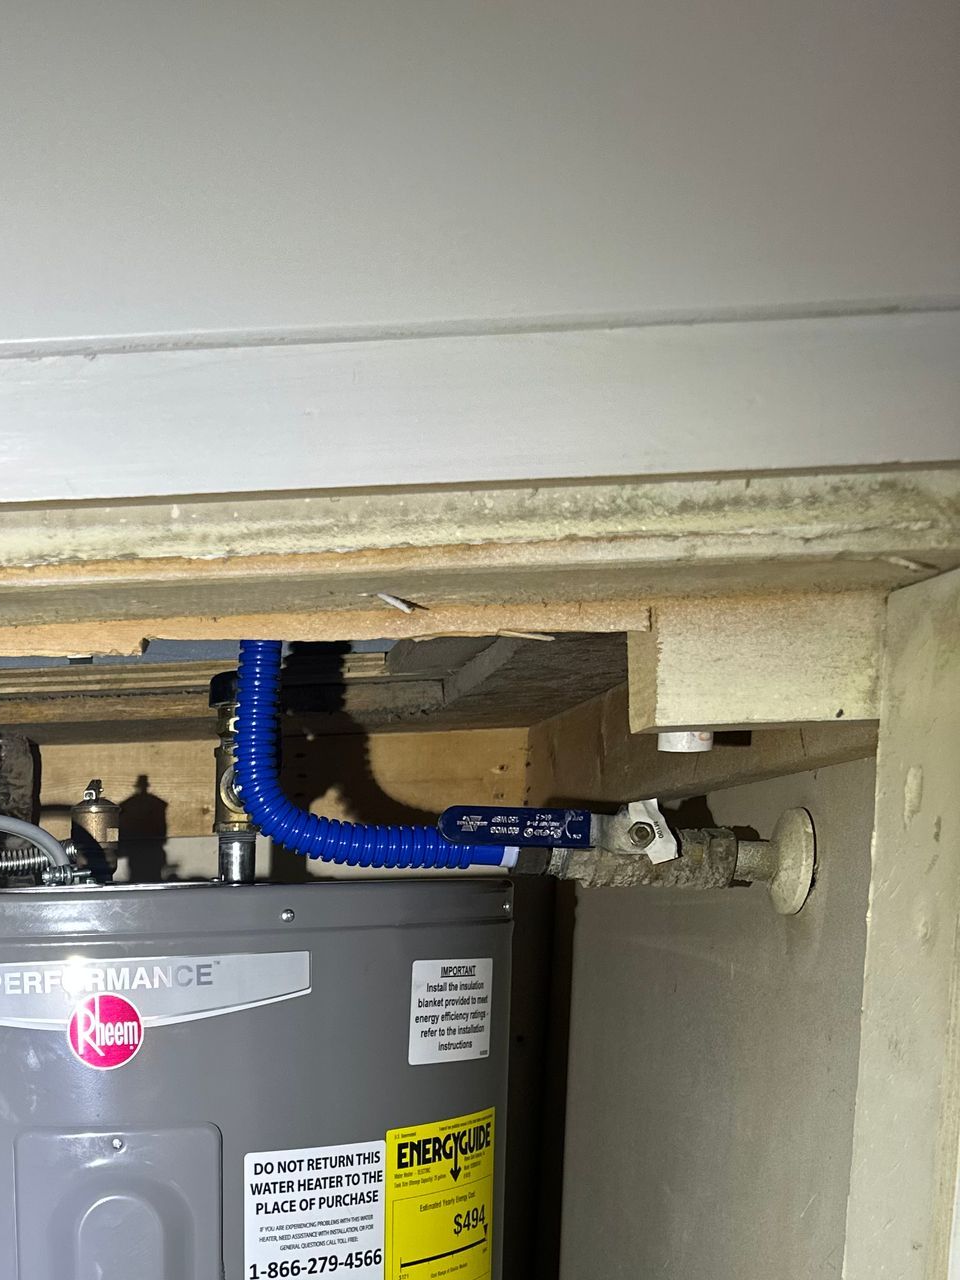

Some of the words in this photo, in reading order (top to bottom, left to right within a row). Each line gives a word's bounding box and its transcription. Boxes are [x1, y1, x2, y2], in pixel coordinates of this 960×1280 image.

[440, 965, 476, 977] IMPORTANT
[427, 982, 447, 992] Install
[449, 982, 458, 991] the
[459, 981, 484, 990] insulation
[418, 998, 443, 1008] blanket
[445, 996, 470, 1008] provided
[415, 1014, 439, 1024] energy
[441, 1010, 469, 1022] efficiency
[75, 994, 139, 1056] Rheem
[421, 1027, 437, 1038] refer
[447, 1026, 456, 1035] the
[458, 1024, 484, 1034] installation
[397, 1122, 491, 1171] ENERGYGUIDE
[254, 1162, 274, 1175] DO
[278, 1159, 304, 1174] NOT
[307, 1154, 354, 1171] RETURN
[356, 1151, 381, 1165] THIS
[250, 1180, 294, 1195] WATER
[298, 1175, 343, 1192] HEATER
[345, 1173, 360, 1187] TO
[362, 1170, 383, 1184] THE
[256, 1200, 296, 1215] PLACE
[300, 1197, 315, 1211] OF
[319, 1190, 379, 1209] PURCHASE
[420, 1200, 441, 1212] Estimated
[285, 1222, 316, 1230] EXPERIENCING
[317, 1219, 339, 1227] PROBLEMS
[454, 1204, 485, 1236] $494
[292, 1232, 318, 1240] ASSISTANCE
[301, 1240, 325, 1249] QUESTIONS
[249, 1248, 382, 1280] 1-866-279-4566
